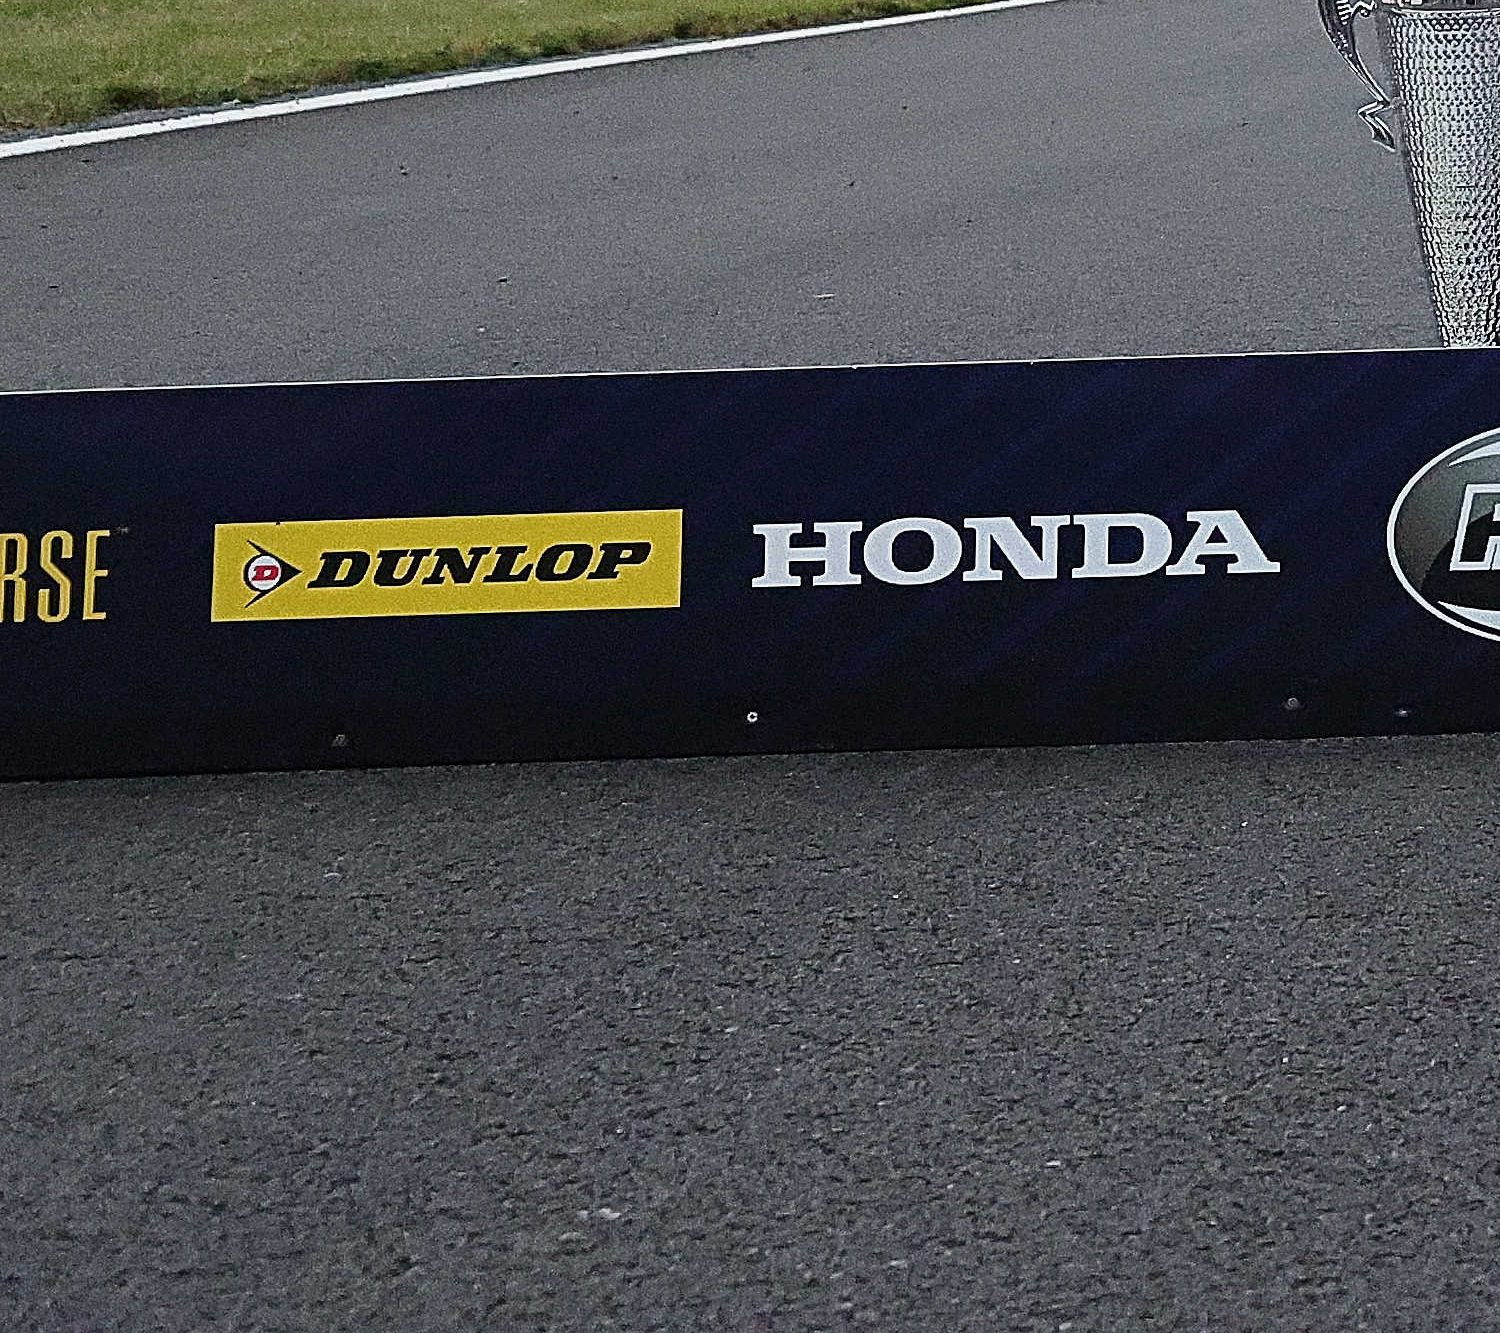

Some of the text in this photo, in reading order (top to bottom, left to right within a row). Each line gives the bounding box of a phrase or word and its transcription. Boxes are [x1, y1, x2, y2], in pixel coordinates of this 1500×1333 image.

[0, 529, 111, 623] RSE
[307, 540, 652, 590] DUNLOP
[752, 509, 1280, 588] HONDA
